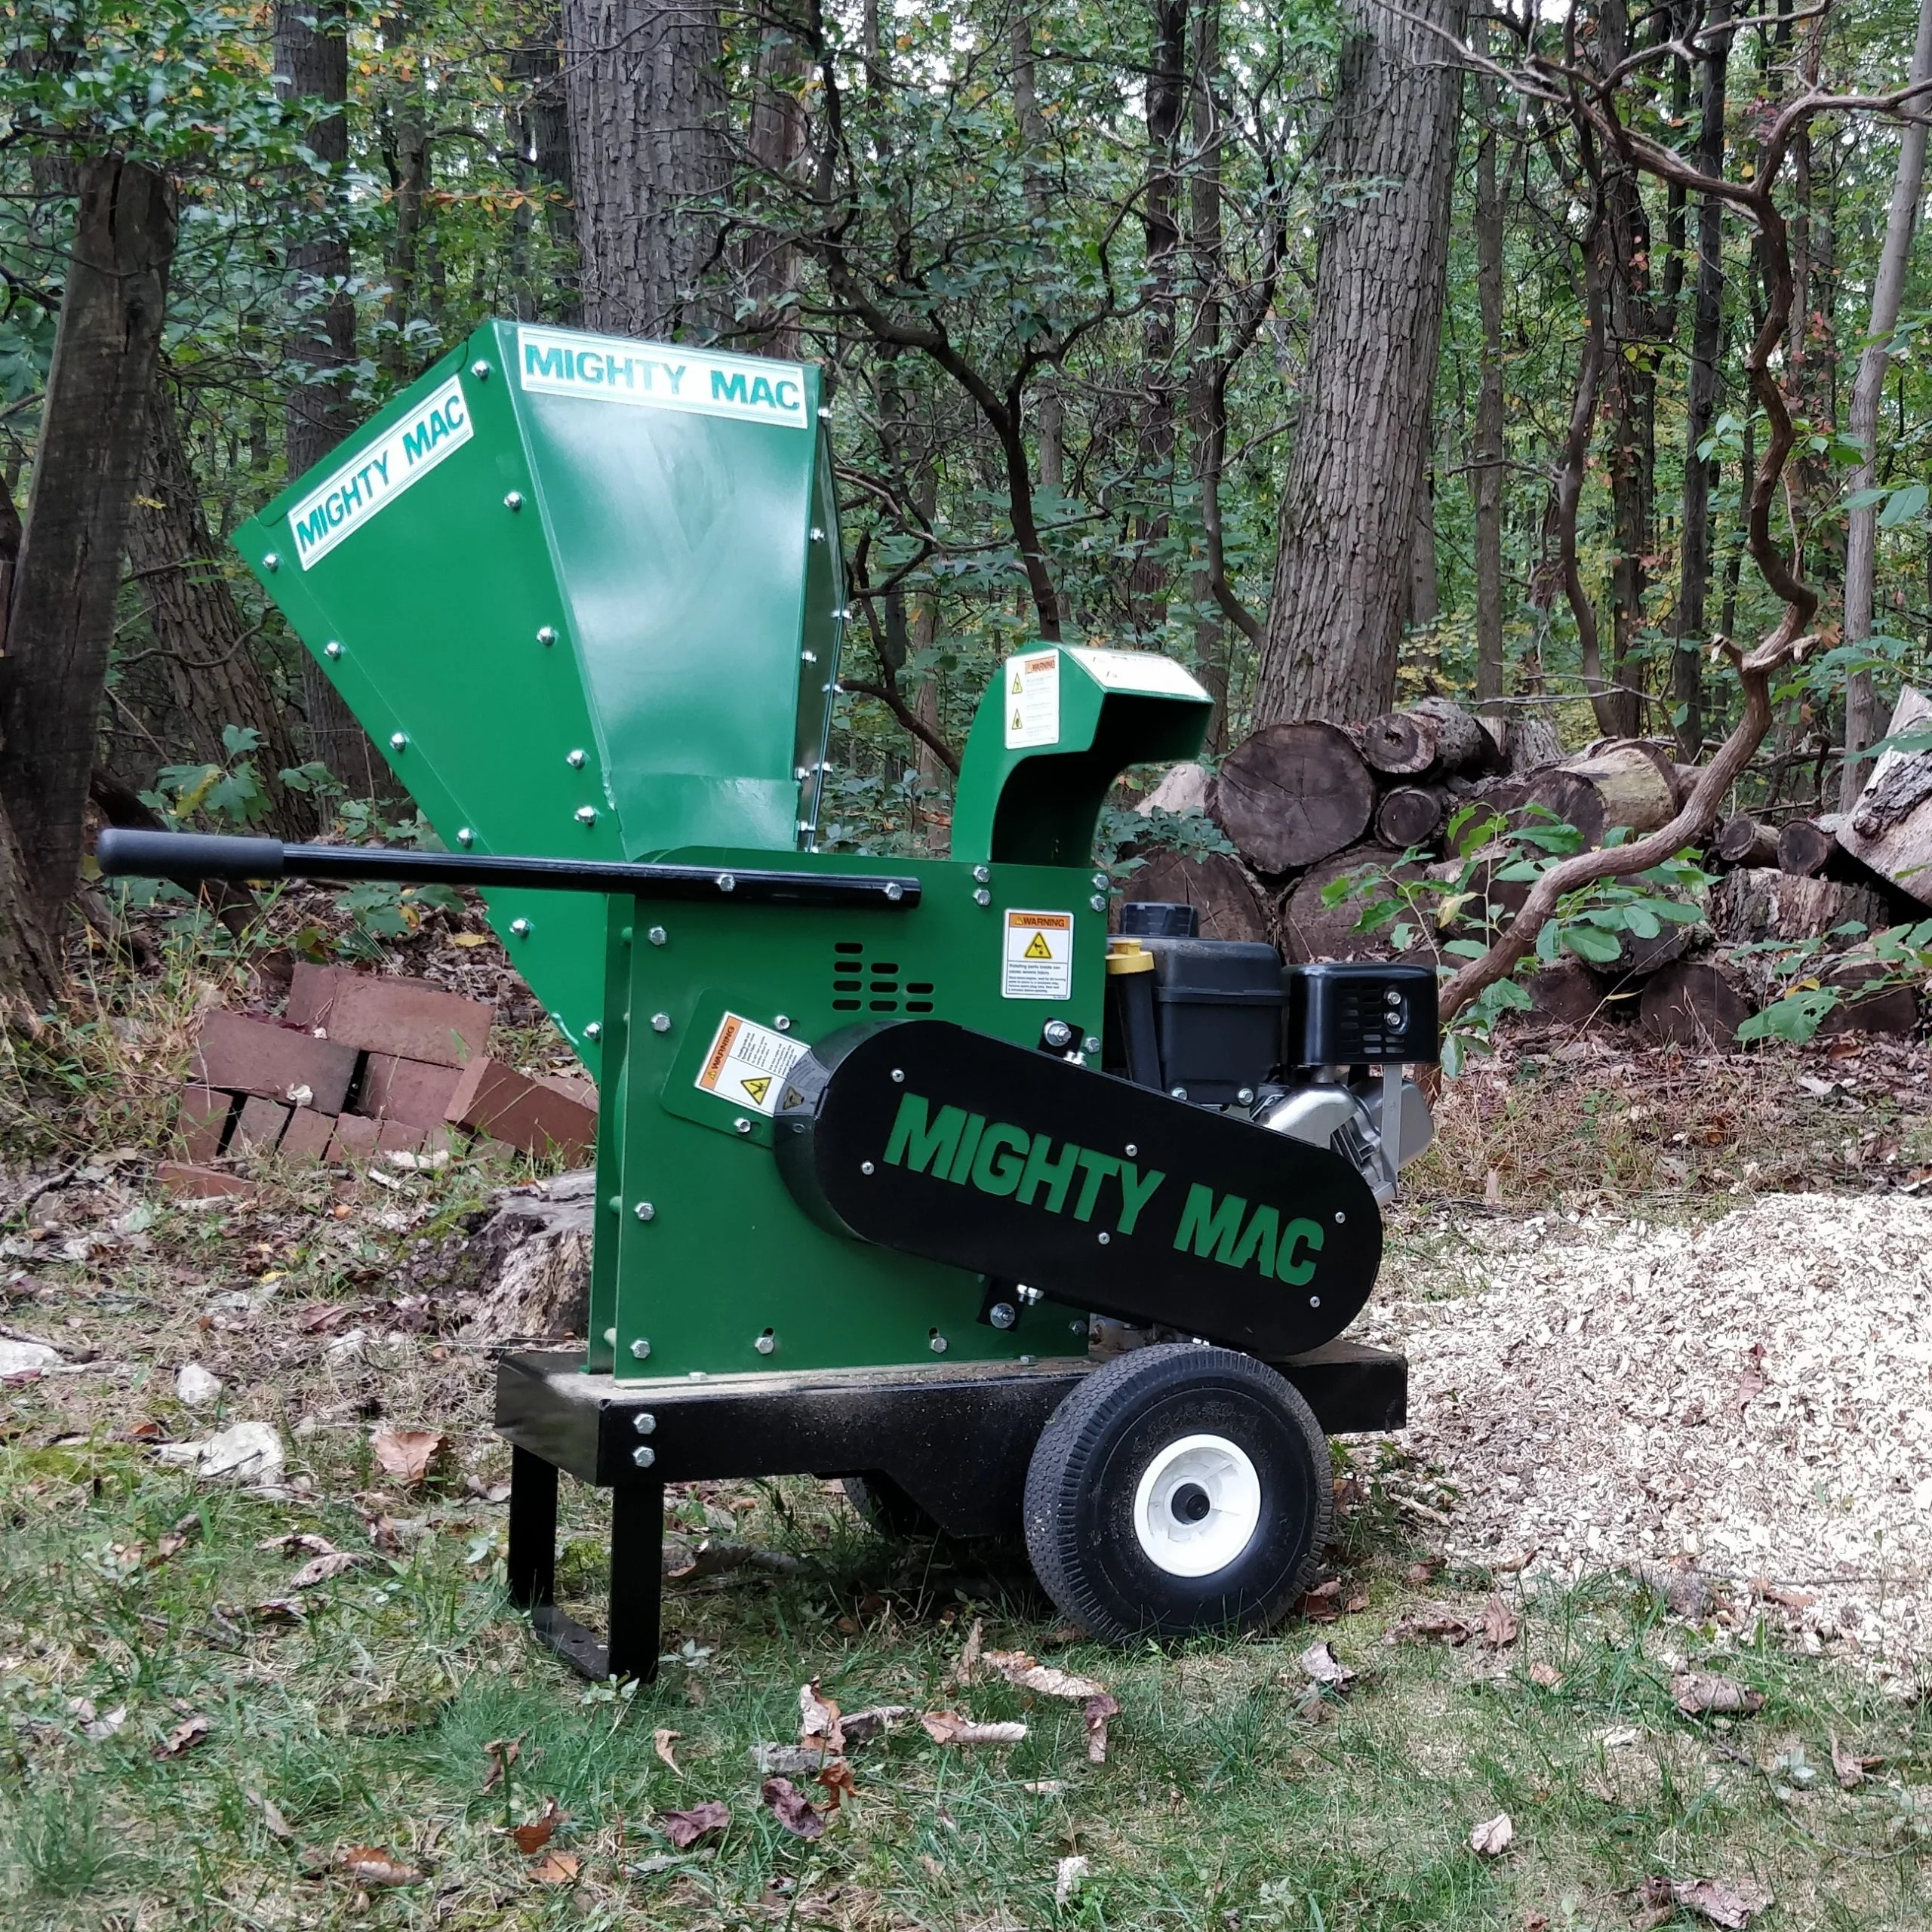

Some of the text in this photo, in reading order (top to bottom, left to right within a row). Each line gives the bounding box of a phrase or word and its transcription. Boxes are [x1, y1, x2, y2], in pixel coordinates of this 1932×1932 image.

[525, 344, 800, 411] MIGHTY MAC
[296, 395, 464, 554] MIGHTY MAC
[1023, 917, 1065, 927] WARNING
[711, 1026, 735, 1069] WARNING
[883, 1092, 1324, 1286] MIGHTY MAC
